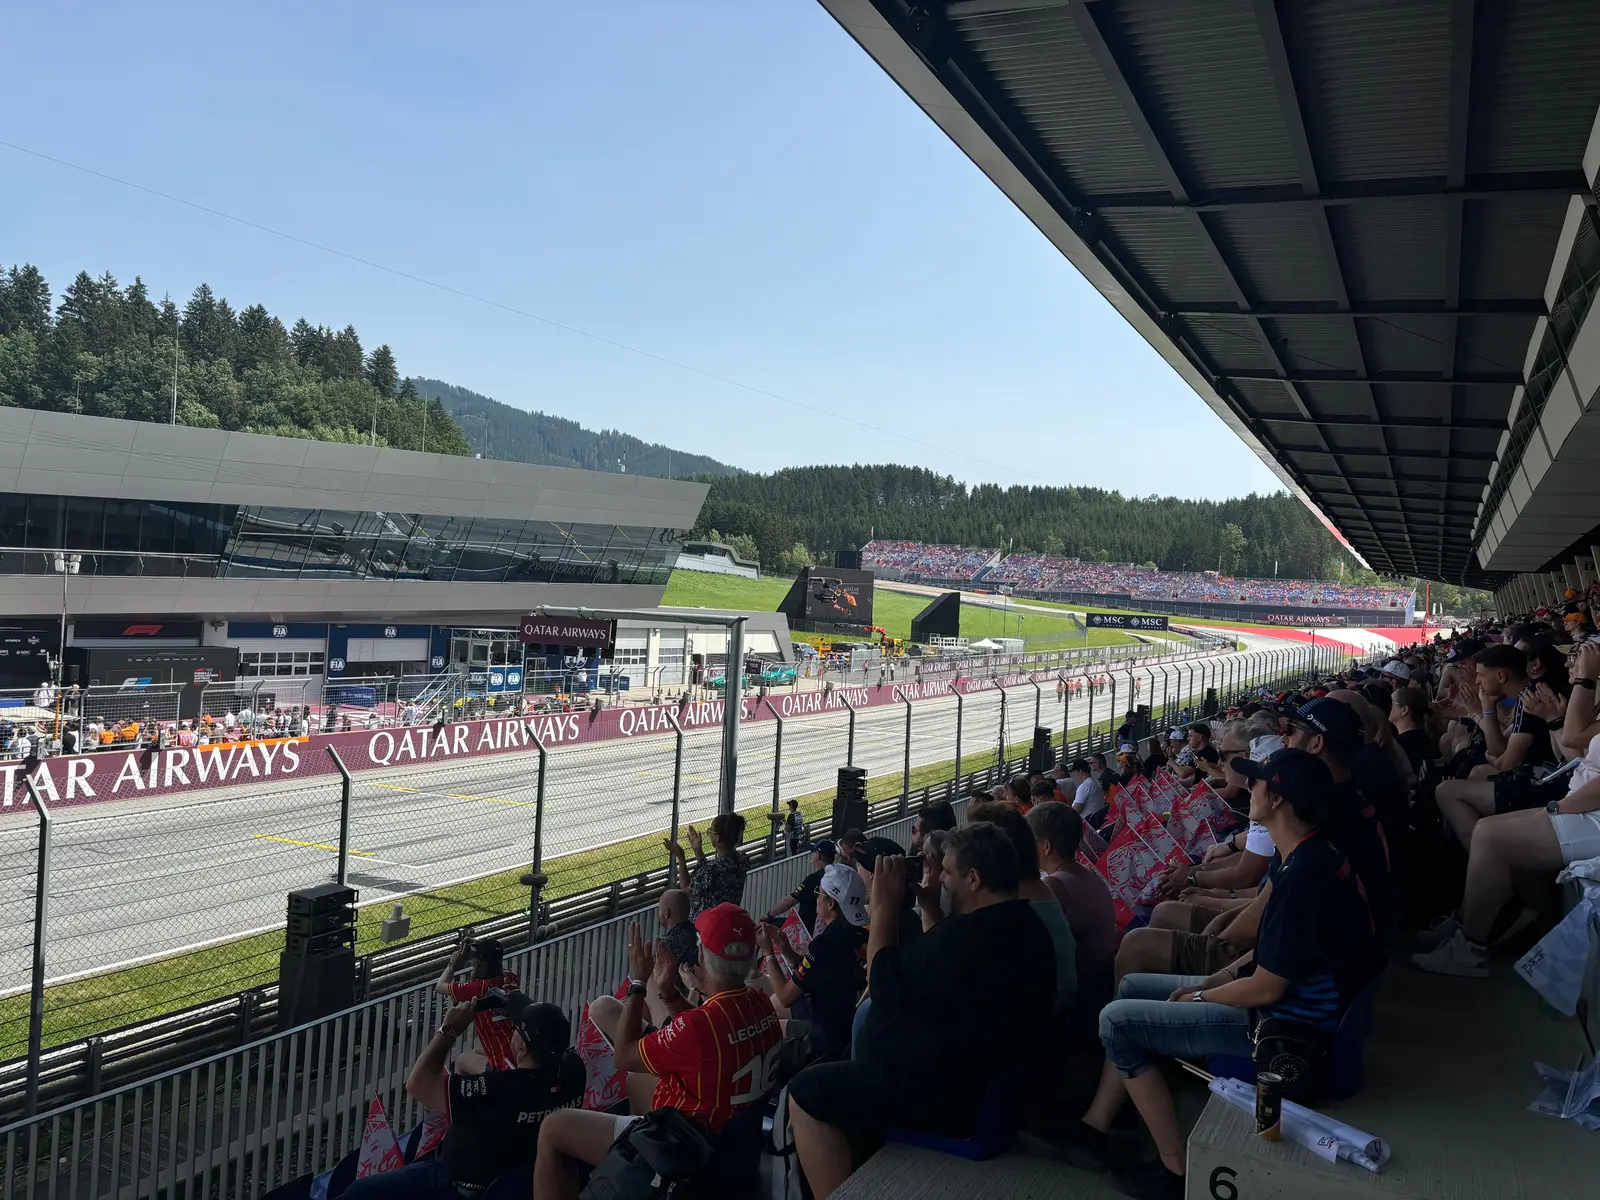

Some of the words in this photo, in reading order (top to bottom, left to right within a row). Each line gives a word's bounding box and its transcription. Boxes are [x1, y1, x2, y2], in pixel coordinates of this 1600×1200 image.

[1103, 616, 1124, 624] MSC
[1141, 617, 1162, 626] MSC
[1267, 614, 1295, 622] QATAR
[1296, 615, 1330, 623] AIRWAYS
[273, 625, 287, 637] FIA
[385, 627, 397, 637] FIA
[524, 624, 559, 636] QATAR
[561, 627, 606, 640] AIRWAYS
[330, 659, 345, 671] FIA
[432, 657, 444, 667] FIA
[491, 673, 503, 685] FIA
[508, 673, 520, 685] FIA
[892, 684, 920, 702] QATAR
[921, 679, 953, 697] AIRWAYS
[782, 692, 821, 717] QATAR
[825, 688, 868, 710] AIRWAYS
[619, 705, 680, 736] QATAR
[368, 725, 469, 766] QATAR
[477, 714, 579, 751] AIRWAYS
[112, 740, 300, 793] AIRWAYS
[479, 1076, 487, 1095] EPSON
[1209, 1166, 1238, 1200] 6
